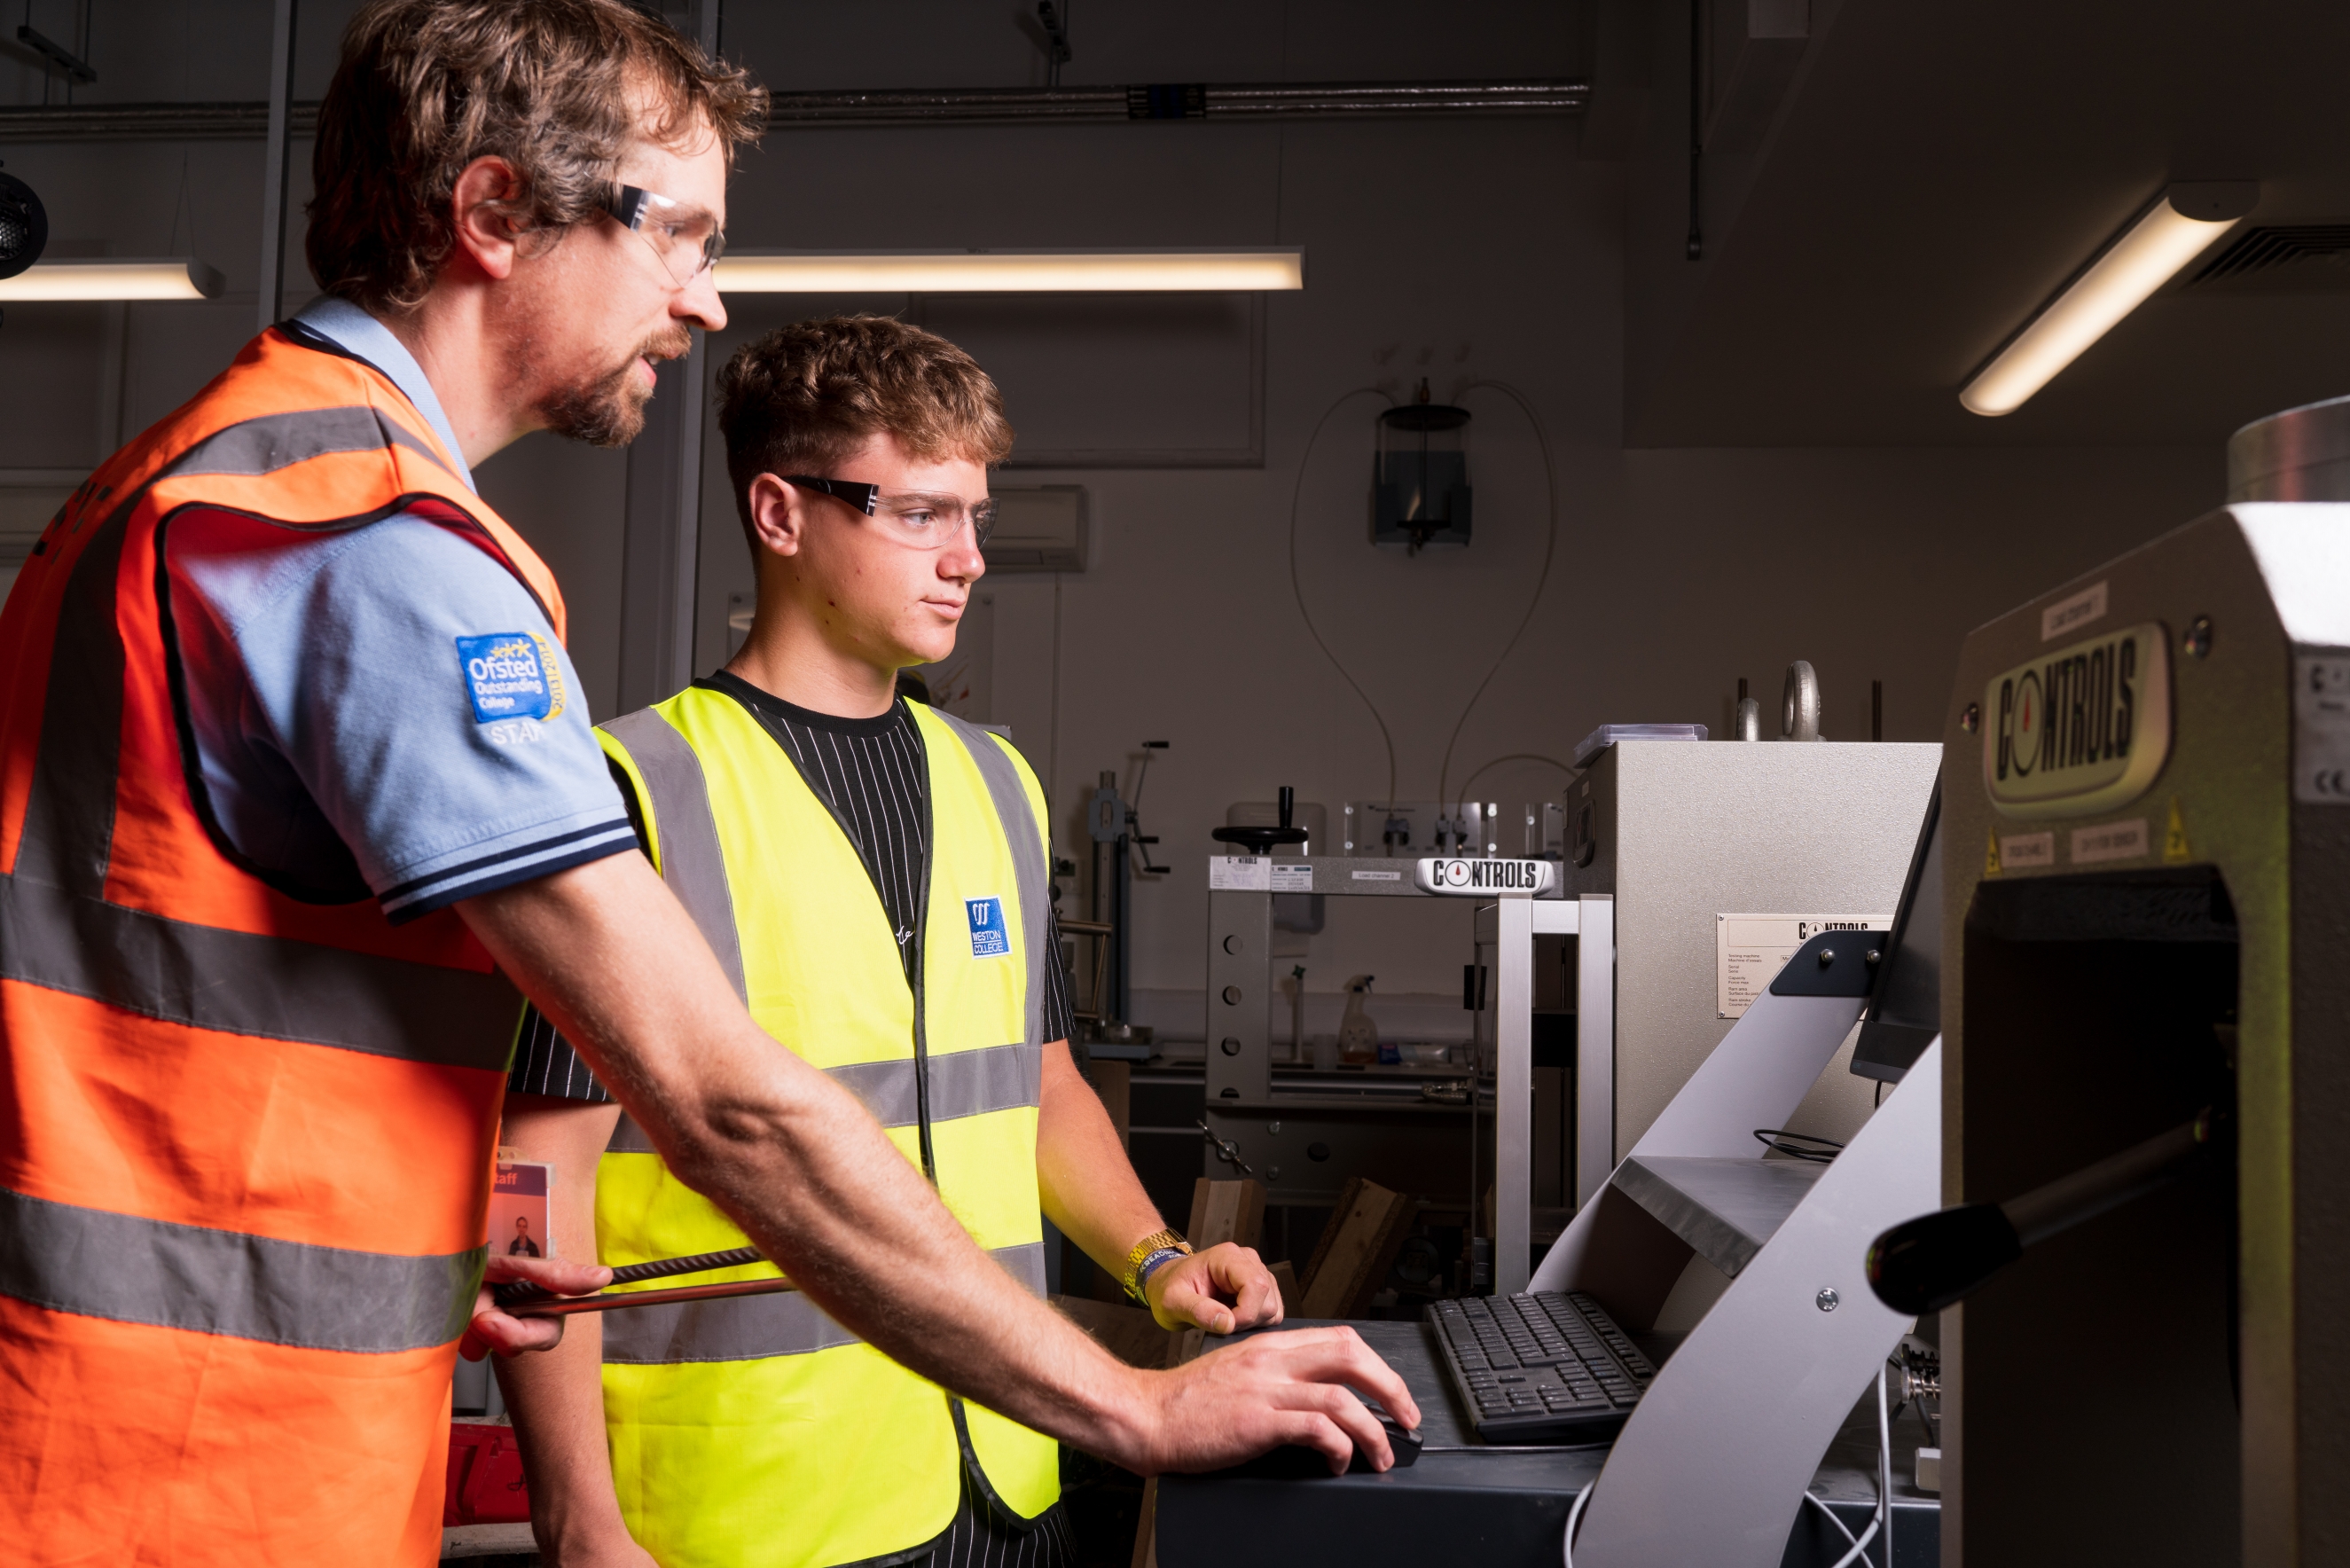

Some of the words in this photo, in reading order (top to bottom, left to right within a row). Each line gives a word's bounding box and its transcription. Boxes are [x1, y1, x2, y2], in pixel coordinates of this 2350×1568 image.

[469, 654, 539, 680] Ofsted
[474, 678, 544, 694] Outstanding
[479, 697, 515, 710] College
[1997, 637, 2135, 780] CONTROLS
[490, 720, 547, 745] STAF
[1433, 859, 1536, 889] CONTROLS
[972, 930, 1001, 942] WESTON
[974, 943, 1004, 953] COLLEGE
[495, 1172, 518, 1185] taff
